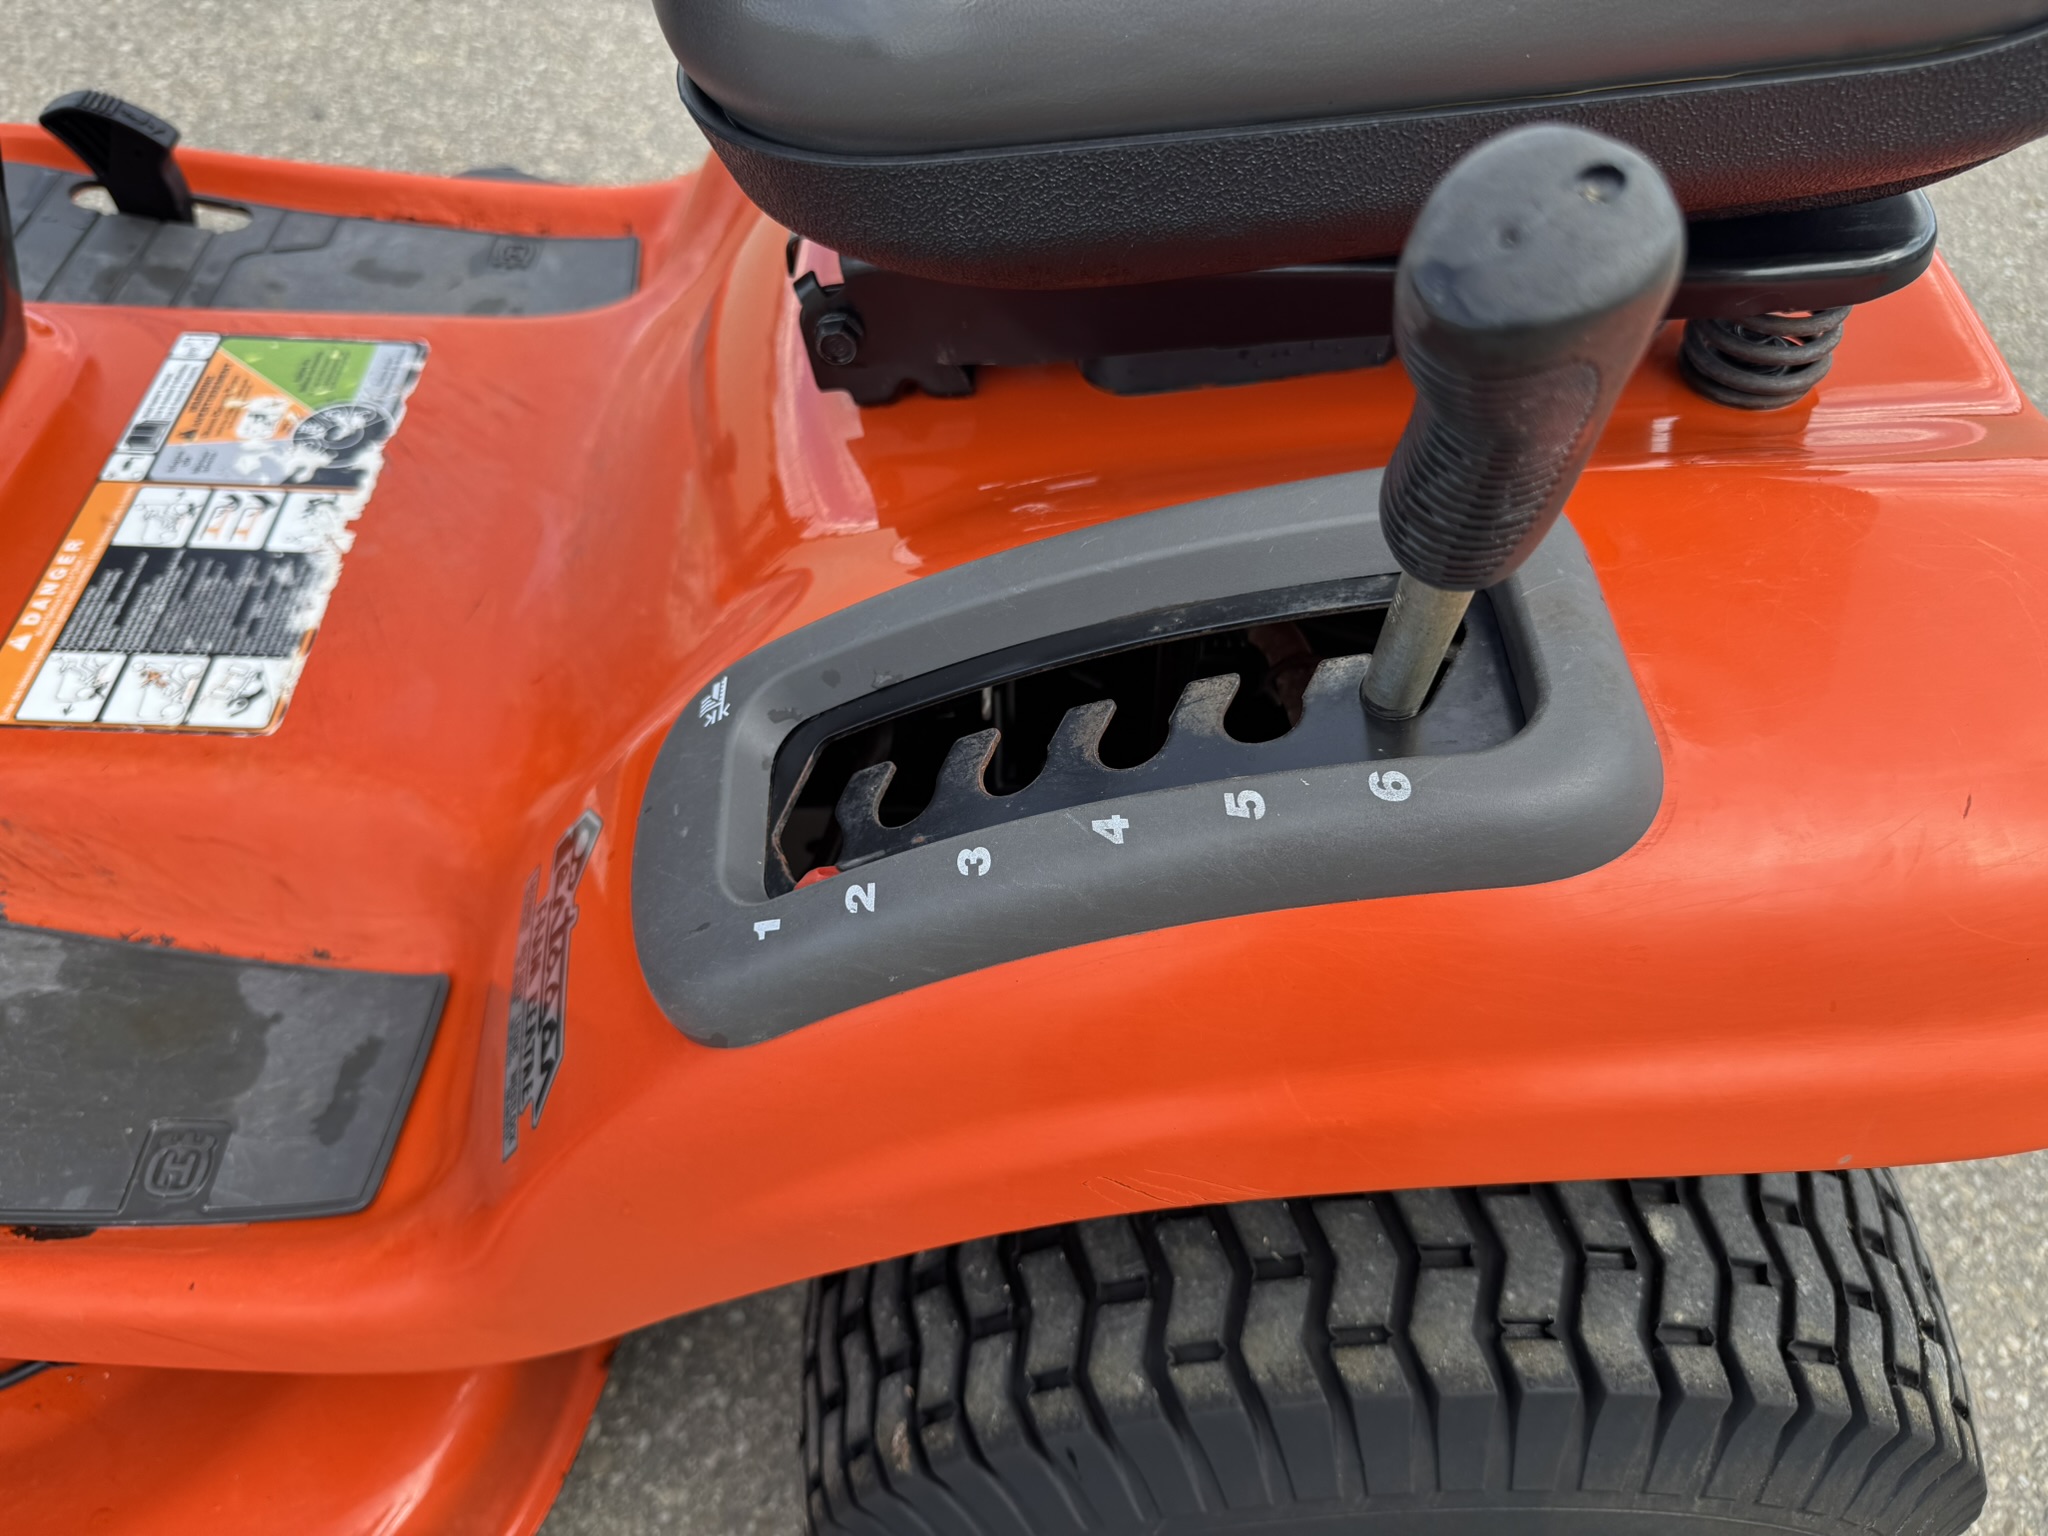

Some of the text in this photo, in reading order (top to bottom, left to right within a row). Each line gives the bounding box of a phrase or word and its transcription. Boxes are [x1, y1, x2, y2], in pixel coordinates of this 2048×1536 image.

[20, 538, 85, 626] DANGER
[1367, 770, 1412, 803] 6
[1223, 789, 1267, 821] 5
[1091, 814, 1130, 845] 4
[956, 846, 992, 877] 3
[844, 882, 876, 914] 2
[752, 918, 781, 941] 1
[520, 990, 540, 1106] CENTRE
